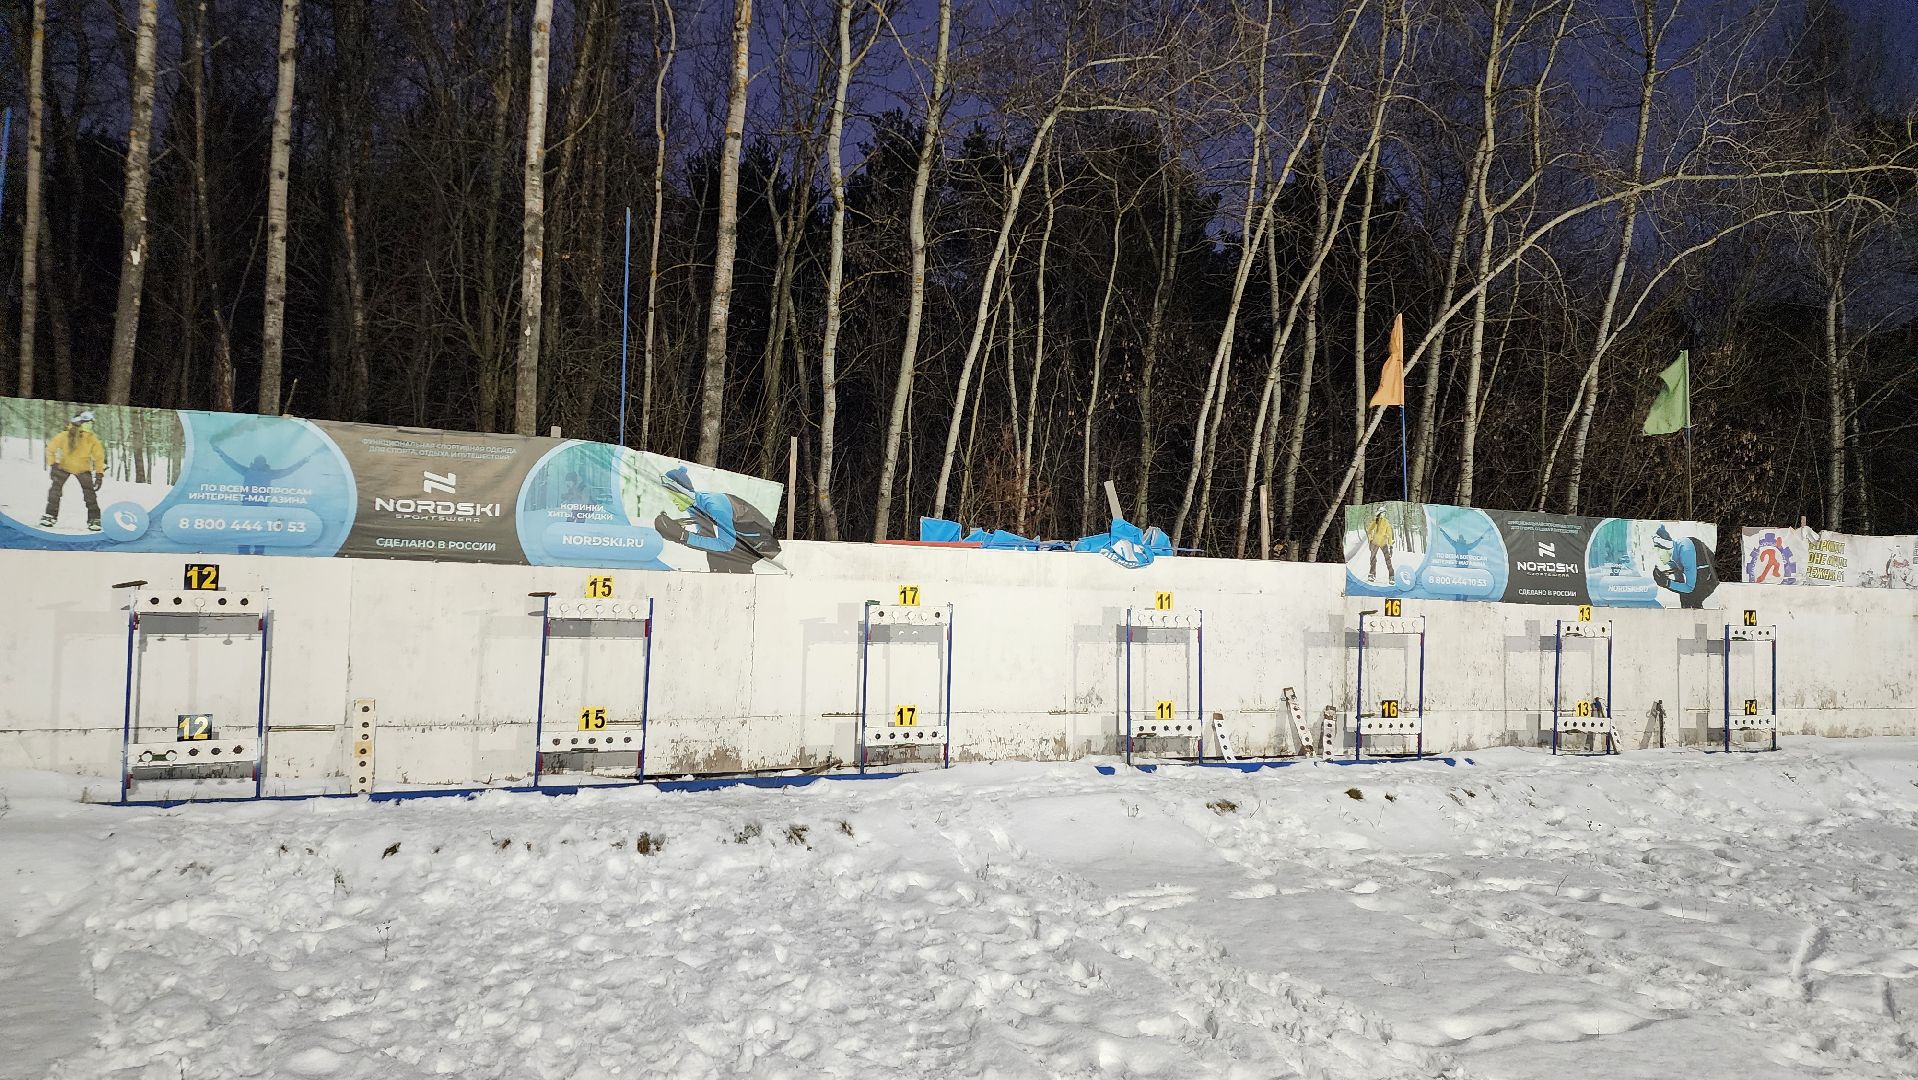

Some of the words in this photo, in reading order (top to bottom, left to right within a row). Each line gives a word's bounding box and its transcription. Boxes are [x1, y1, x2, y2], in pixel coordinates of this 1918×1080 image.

[200, 483, 217, 492] ПО
[219, 484, 249, 493] ВСЕМ
[251, 485, 312, 496] ВОПРОСАМ
[188, 492, 308, 504] ИНТЕРНЕТ-МАГАЗИНА
[374, 497, 500, 517] NORDSKI
[395, 513, 481, 522] SPORTSWEAR
[547, 510, 576, 519] ХИТЫ,
[576, 512, 614, 520] СКИДКИ
[179, 518, 190, 529] 8
[194, 518, 226, 530] 800
[231, 520, 263, 531] 444
[266, 520, 283, 532] 10
[287, 521, 307, 533] 53
[375, 537, 435, 549] СДЕЛАНО
[438, 541, 446, 549] В
[448, 541, 497, 551] РОССИИ
[562, 535, 645, 548] NORDSKI.RU
[1517, 561, 1579, 574] NORDSKI
[187, 566, 217, 589] 12
[1429, 576, 1435, 584] 8
[1435, 576, 1451, 585] 800
[1452, 577, 1467, 586] 444
[1467, 578, 1477, 586] 10
[1477, 579, 1488, 587] 53
[590, 578, 612, 597] 15
[1518, 588, 1546, 597] СДЕЛАНО
[900, 587, 918, 605] 17
[1158, 594, 1171, 610] 11
[1385, 599, 1401, 616] 16
[1580, 606, 1591, 621] 13
[1745, 611, 1757, 626] 14
[1158, 703, 1172, 719] 11
[1383, 700, 1398, 717] 16
[1577, 702, 1589, 717] 13
[1745, 701, 1757, 715] 14
[581, 709, 606, 729] 15
[897, 707, 916, 726] 17
[179, 716, 208, 740] 12
